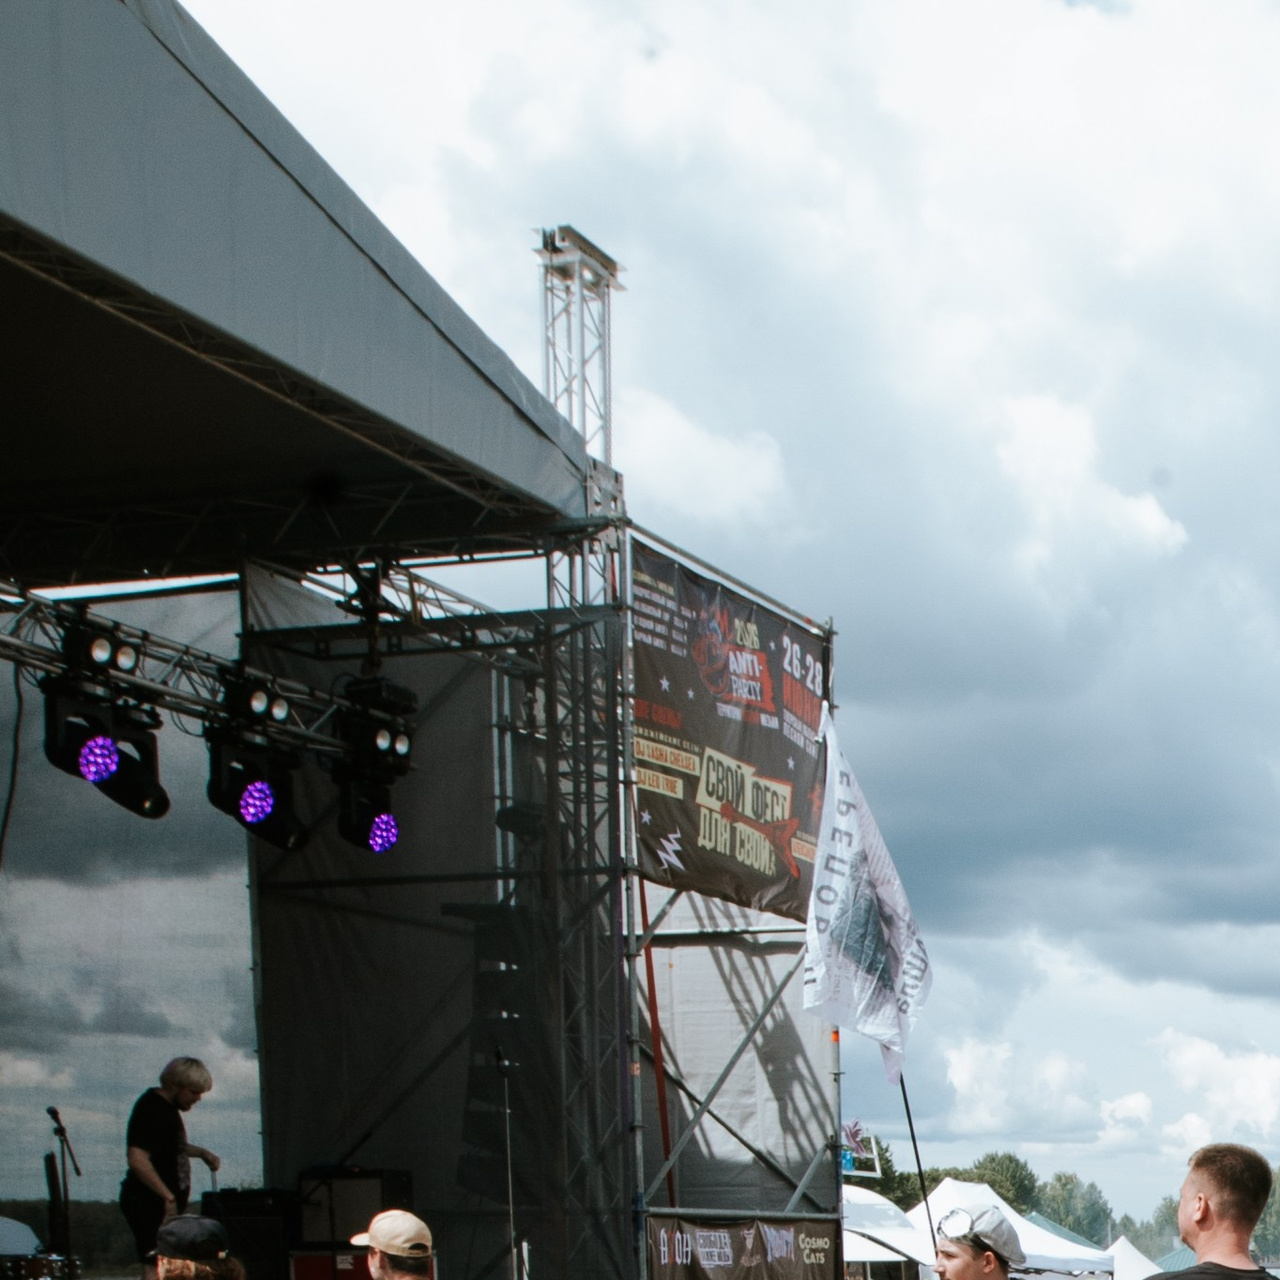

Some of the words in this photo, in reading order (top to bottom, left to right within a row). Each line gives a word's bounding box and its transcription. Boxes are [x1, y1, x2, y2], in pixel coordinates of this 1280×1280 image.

[730, 675, 761, 701] PARTY
[635, 740, 646, 757] DJ
[648, 742, 668, 763] SASHA
[669, 747, 697, 772] CHELSEA
[637, 769, 647, 785] DJ
[661, 776, 678, 795] TRUE
[705, 755, 746, 815] СВОЙ
[752, 780, 788, 822] ФЕСТ
[698, 807, 731, 856] ДЛЯ
[798, 1233, 830, 1249] COSMO
[802, 1250, 826, 1264] CATS
